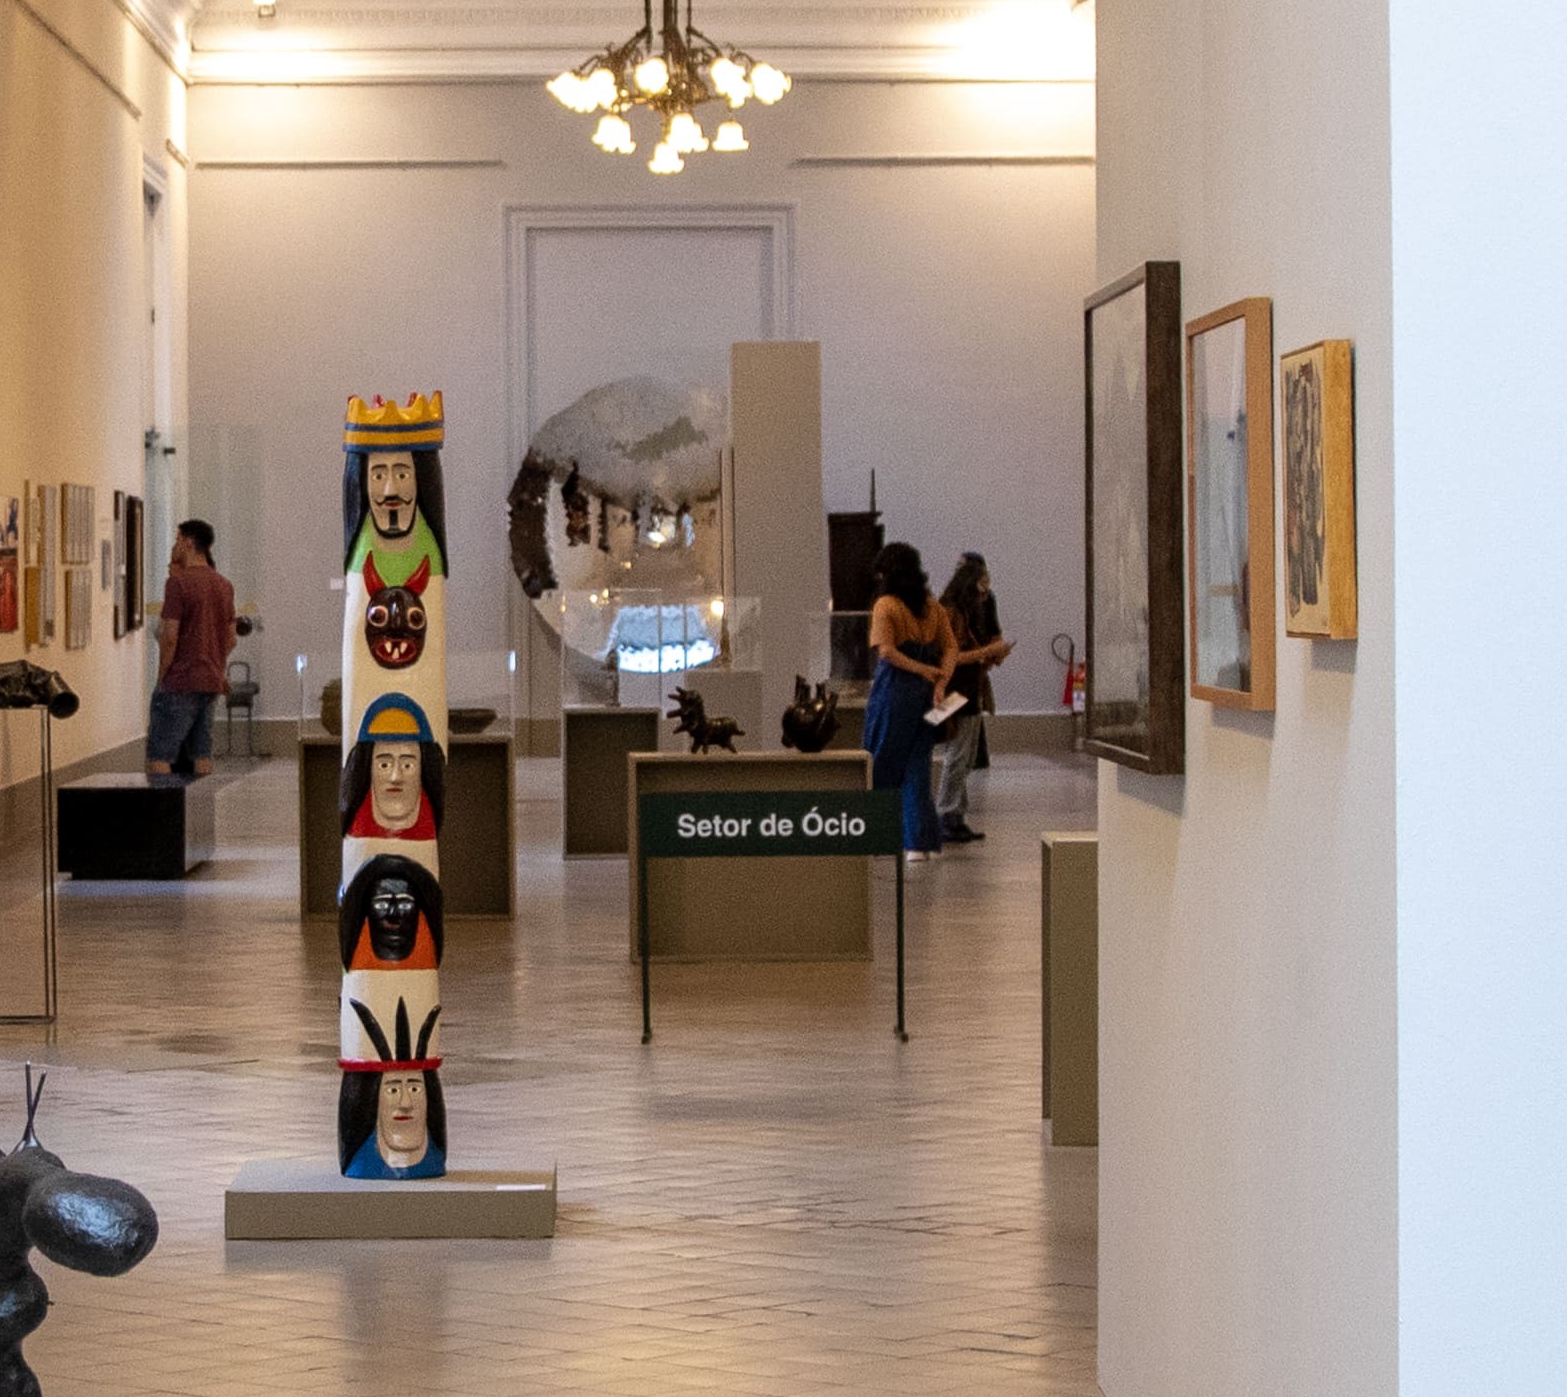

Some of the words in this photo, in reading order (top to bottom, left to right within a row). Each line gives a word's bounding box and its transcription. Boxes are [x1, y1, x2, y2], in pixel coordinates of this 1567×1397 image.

[677, 813, 752, 838] Setor
[759, 813, 794, 837] de
[801, 806, 866, 837] Ócio
